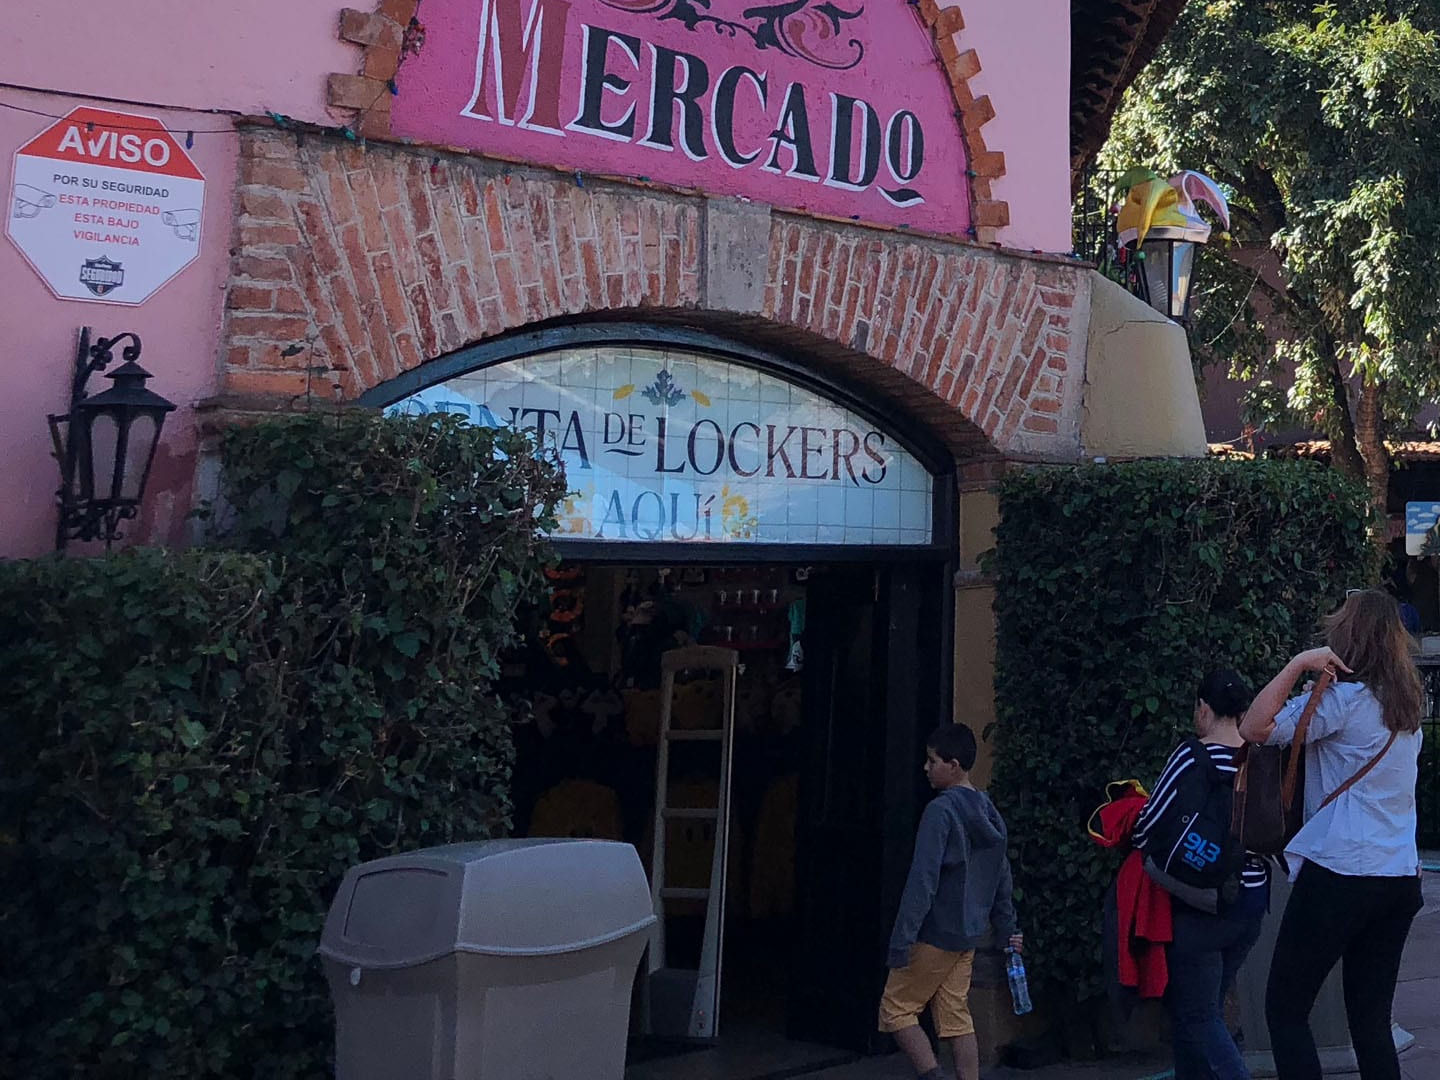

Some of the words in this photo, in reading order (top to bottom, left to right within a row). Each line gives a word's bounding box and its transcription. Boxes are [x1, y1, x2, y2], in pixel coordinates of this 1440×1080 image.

[57, 125, 171, 167] AVISO
[53, 174, 79, 187] POR
[82, 178, 98, 189] SU
[101, 180, 170, 199] SEGURIDAD
[59, 193, 90, 207] ESTA
[92, 198, 160, 216] PROPIEDAD
[74, 212, 105, 225] ESTA
[107, 216, 140, 230] BAJO
[73, 229, 140, 247] VIGILANCIA
[603, 413, 646, 456] DE
[654, 414, 887, 487] LOCKERS
